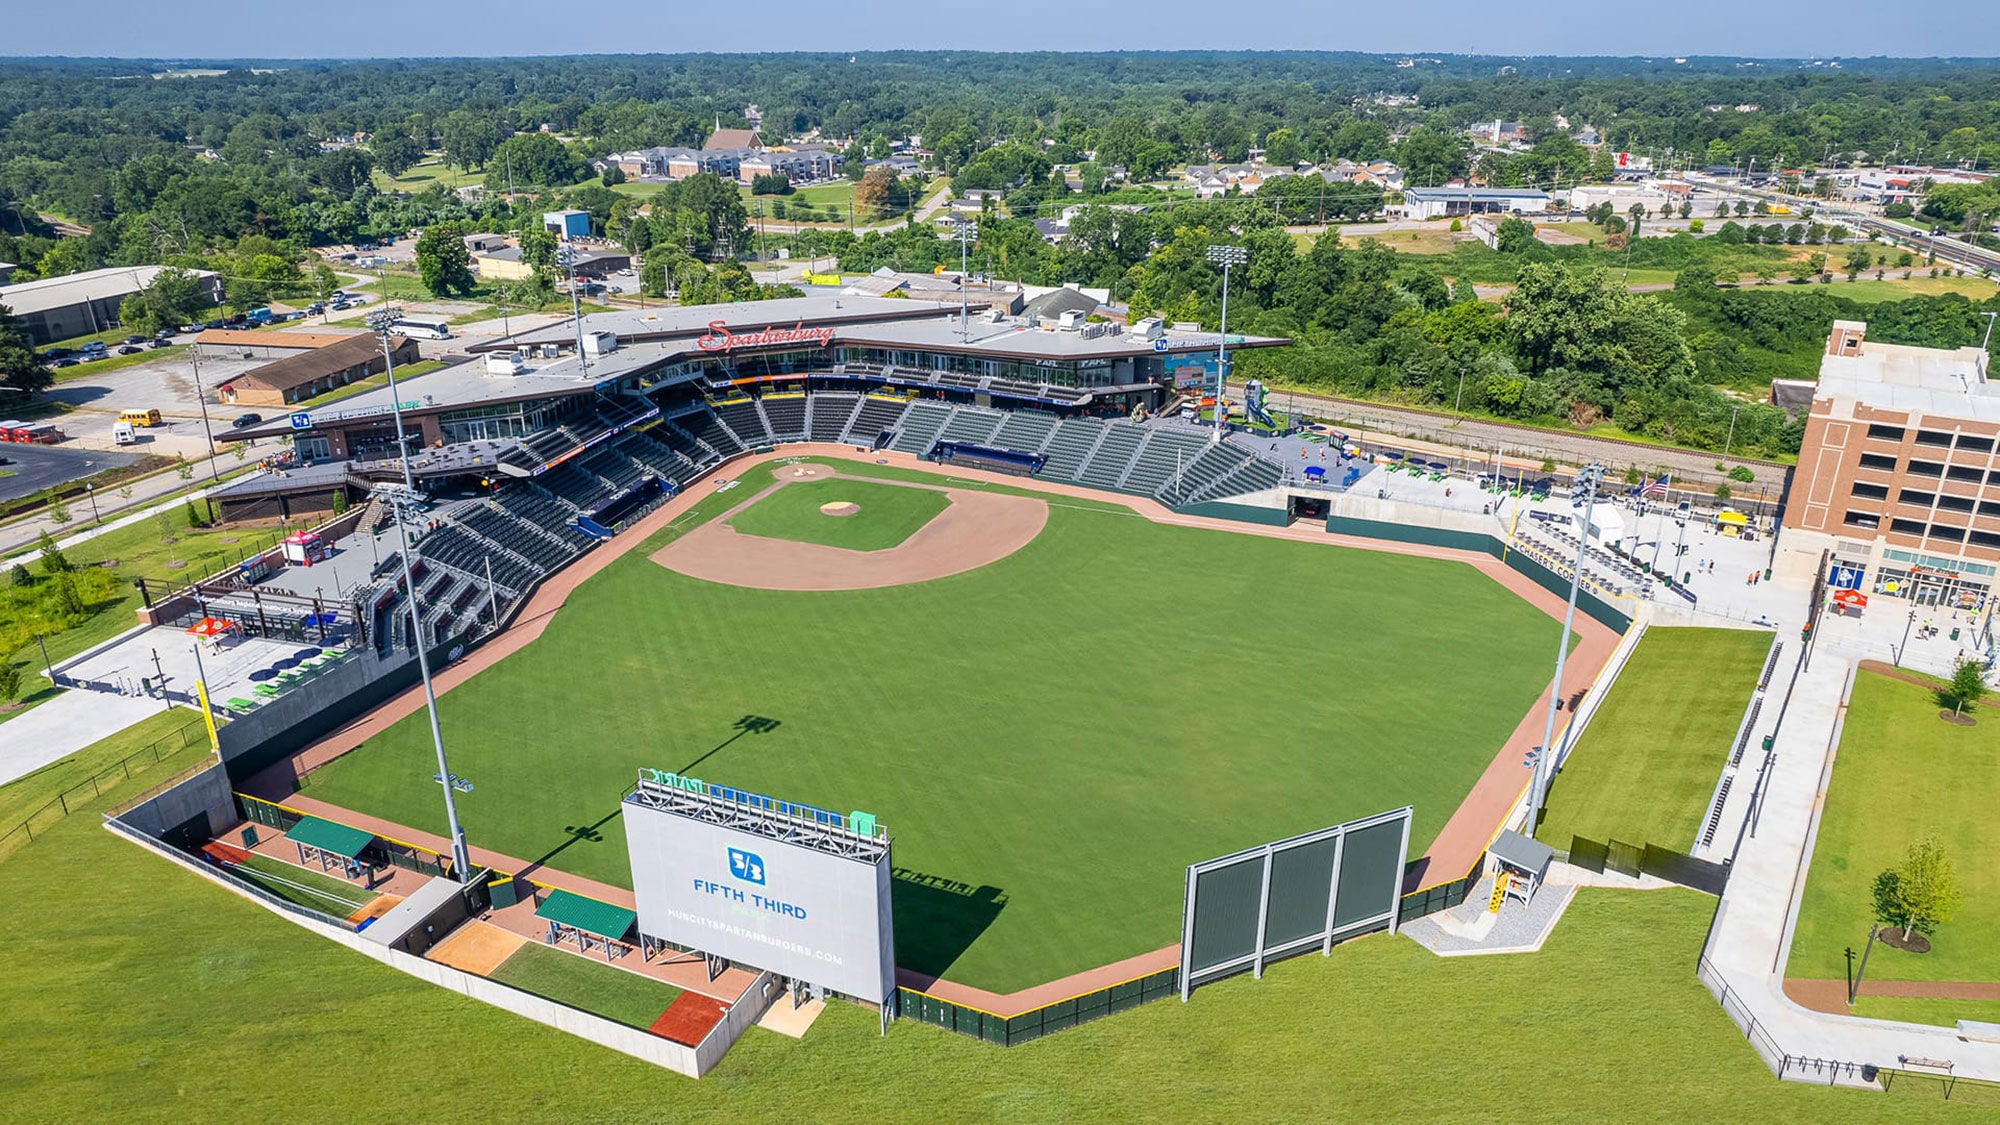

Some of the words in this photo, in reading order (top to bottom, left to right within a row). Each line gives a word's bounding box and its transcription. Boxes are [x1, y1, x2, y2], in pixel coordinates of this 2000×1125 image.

[697, 320, 835, 353] Spartanburg
[1519, 545, 1554, 570] CHASER'S
[693, 879, 744, 903] FIFTH
[751, 894, 807, 920] THIRD
